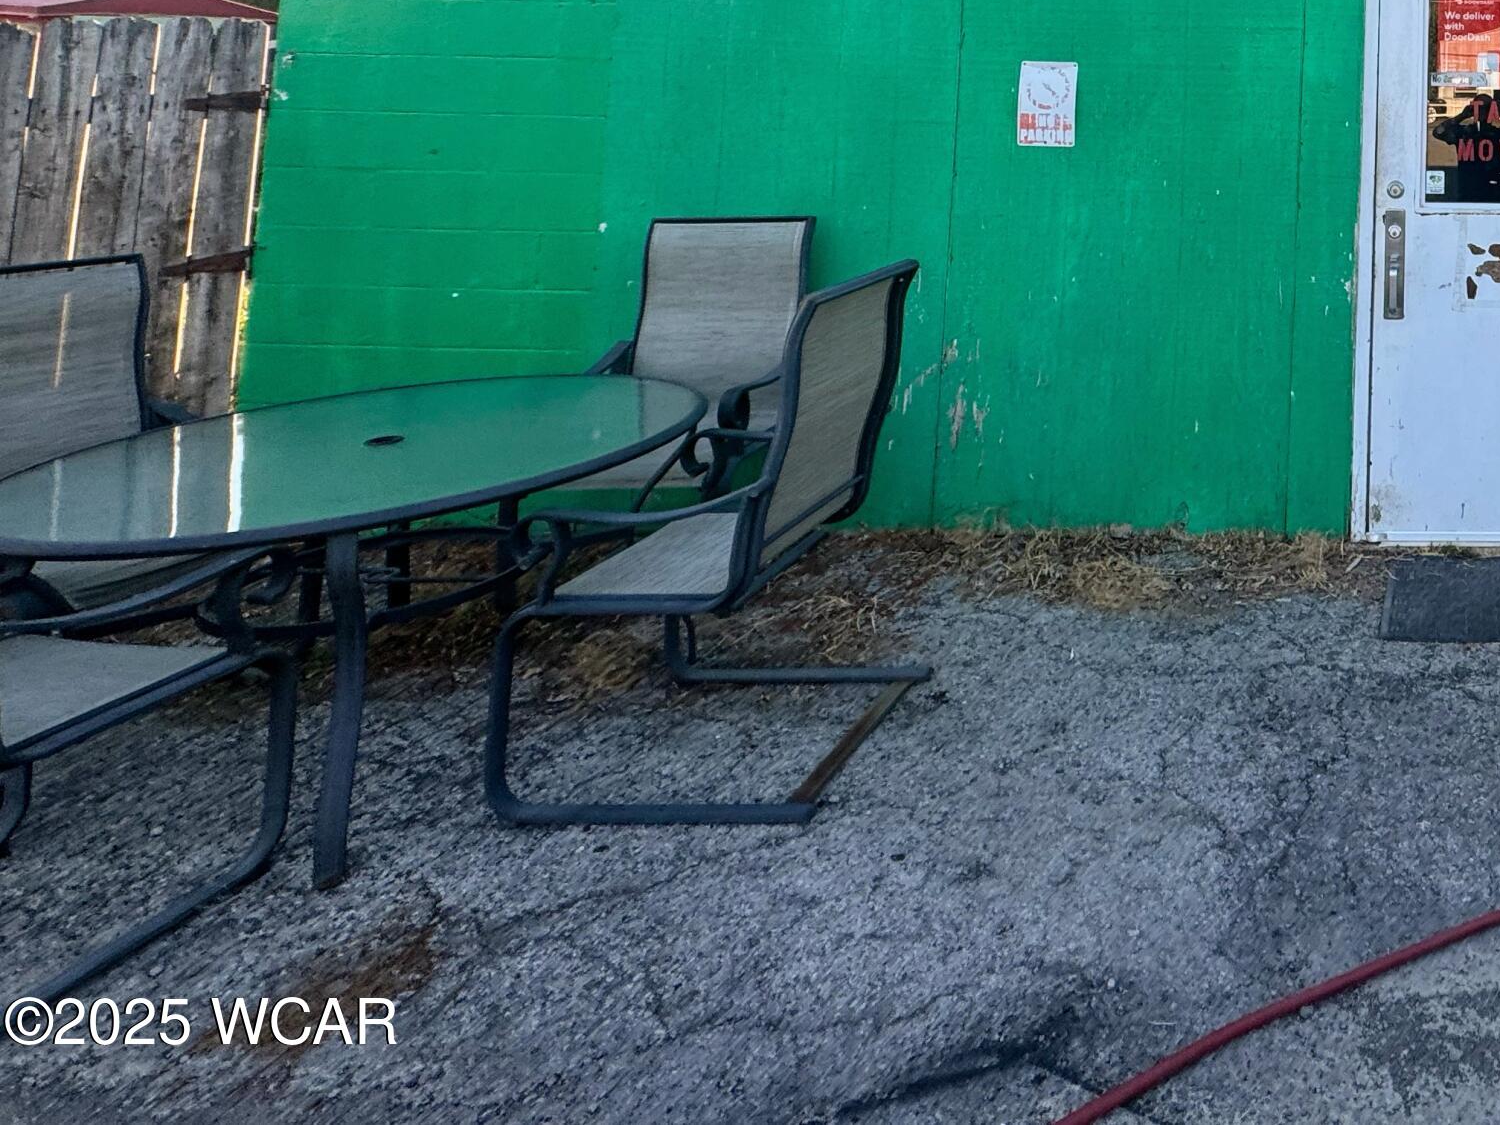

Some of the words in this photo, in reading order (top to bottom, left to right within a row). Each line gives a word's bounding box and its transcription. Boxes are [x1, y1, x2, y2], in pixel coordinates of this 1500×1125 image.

[1444, 11, 1460, 20] We
[1463, 11, 1495, 21] deliver
[1444, 22, 1464, 31] with
[1444, 33, 1491, 42] DoorDash
